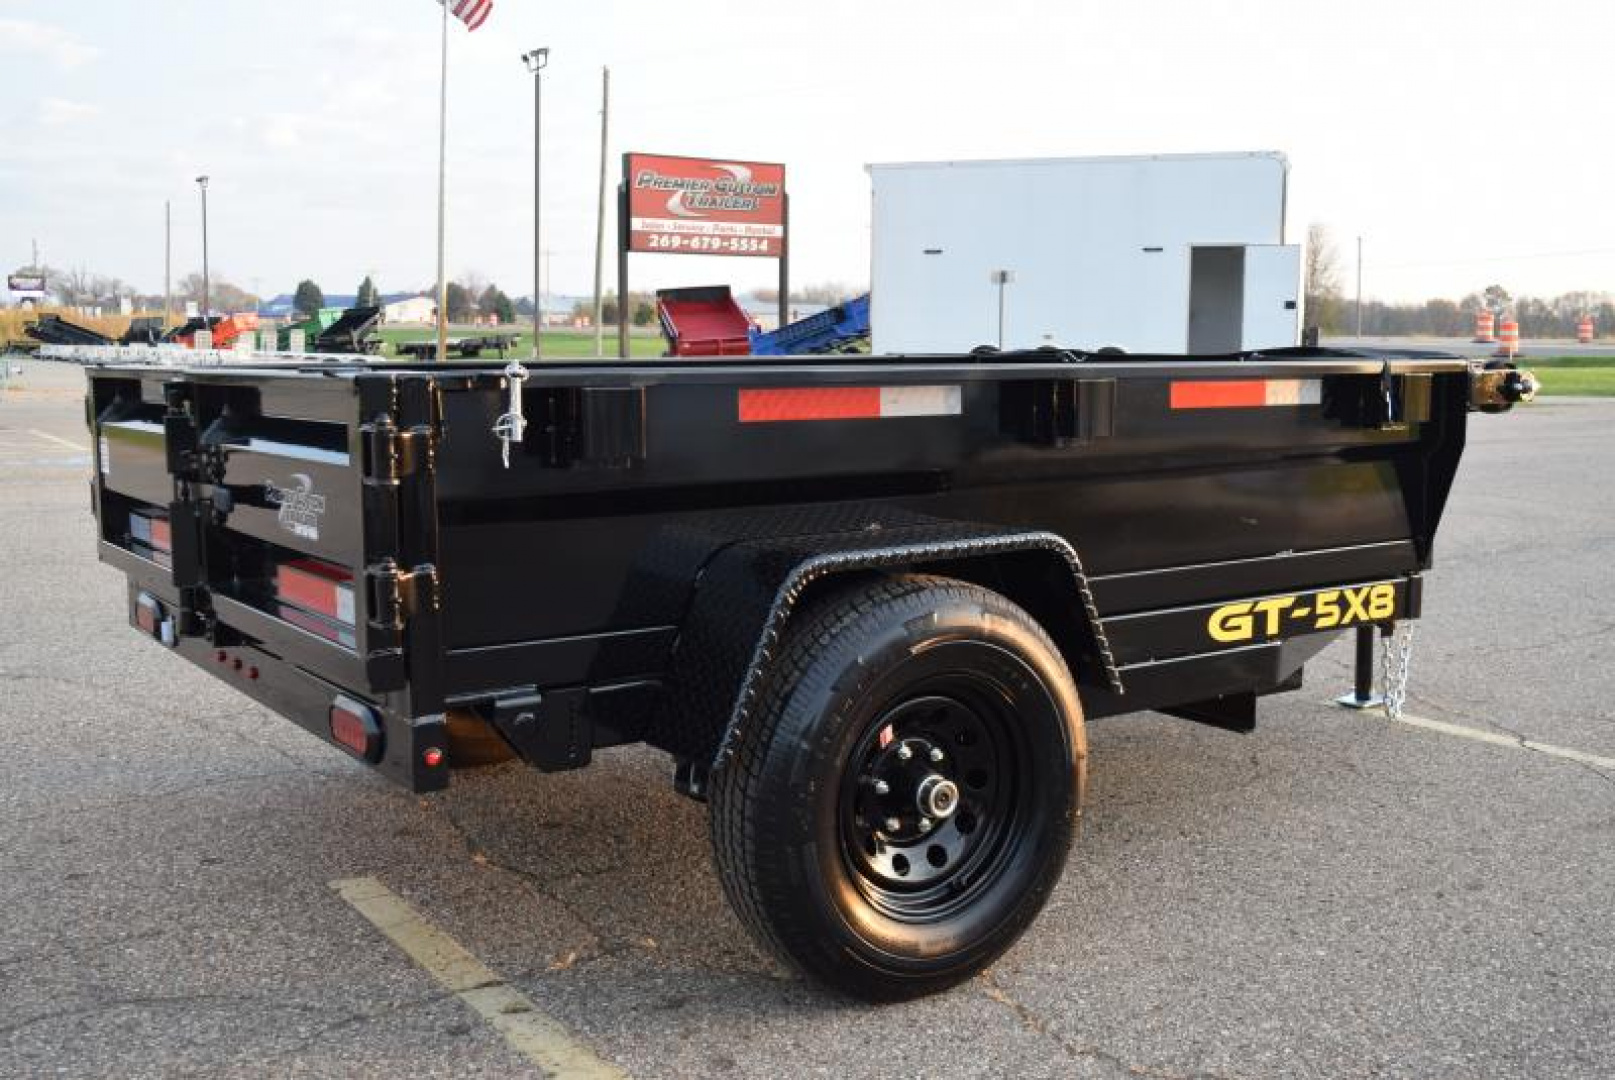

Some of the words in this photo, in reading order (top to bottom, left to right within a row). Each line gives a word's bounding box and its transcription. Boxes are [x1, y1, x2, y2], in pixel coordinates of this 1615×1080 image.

[713, 177, 777, 196] CUTOM
[648, 234, 768, 250] 269-679-5554
[1207, 582, 1395, 643] GT-5X8
